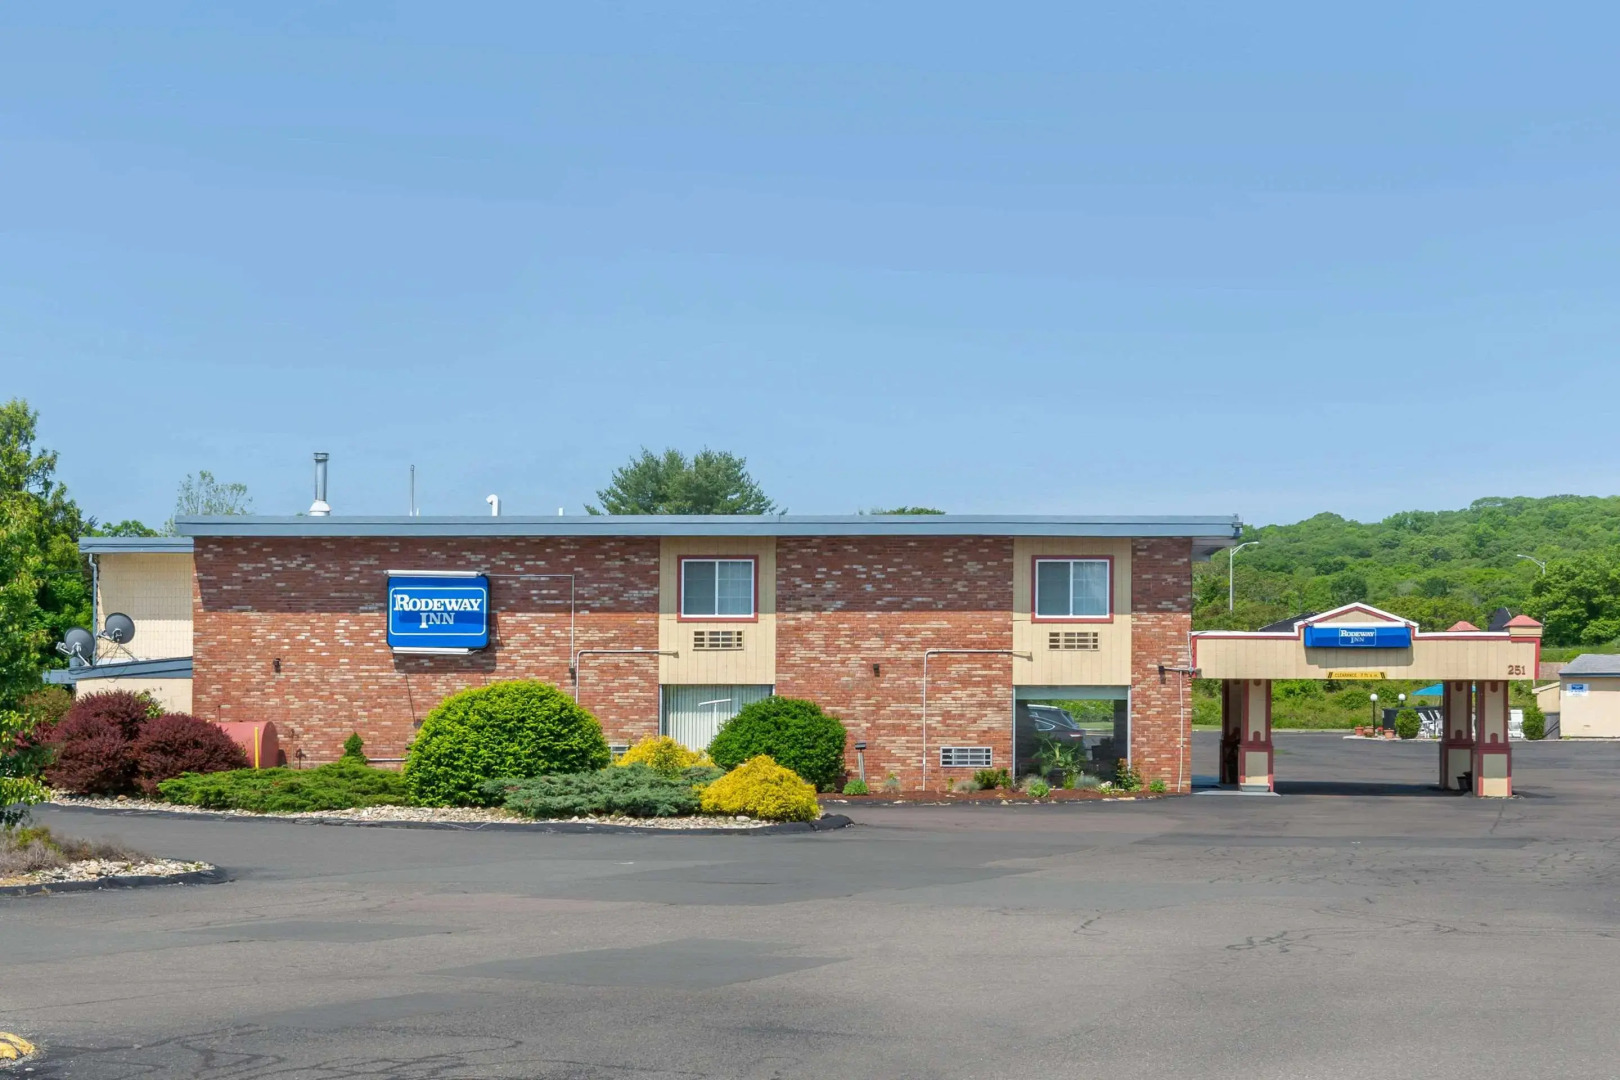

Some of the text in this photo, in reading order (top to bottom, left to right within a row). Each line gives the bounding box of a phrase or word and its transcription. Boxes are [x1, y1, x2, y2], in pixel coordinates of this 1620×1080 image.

[393, 594, 482, 611] RODEWAY
[419, 612, 455, 629] INN
[1340, 629, 1375, 637] RODEWAY
[1507, 664, 1526, 676] 251
